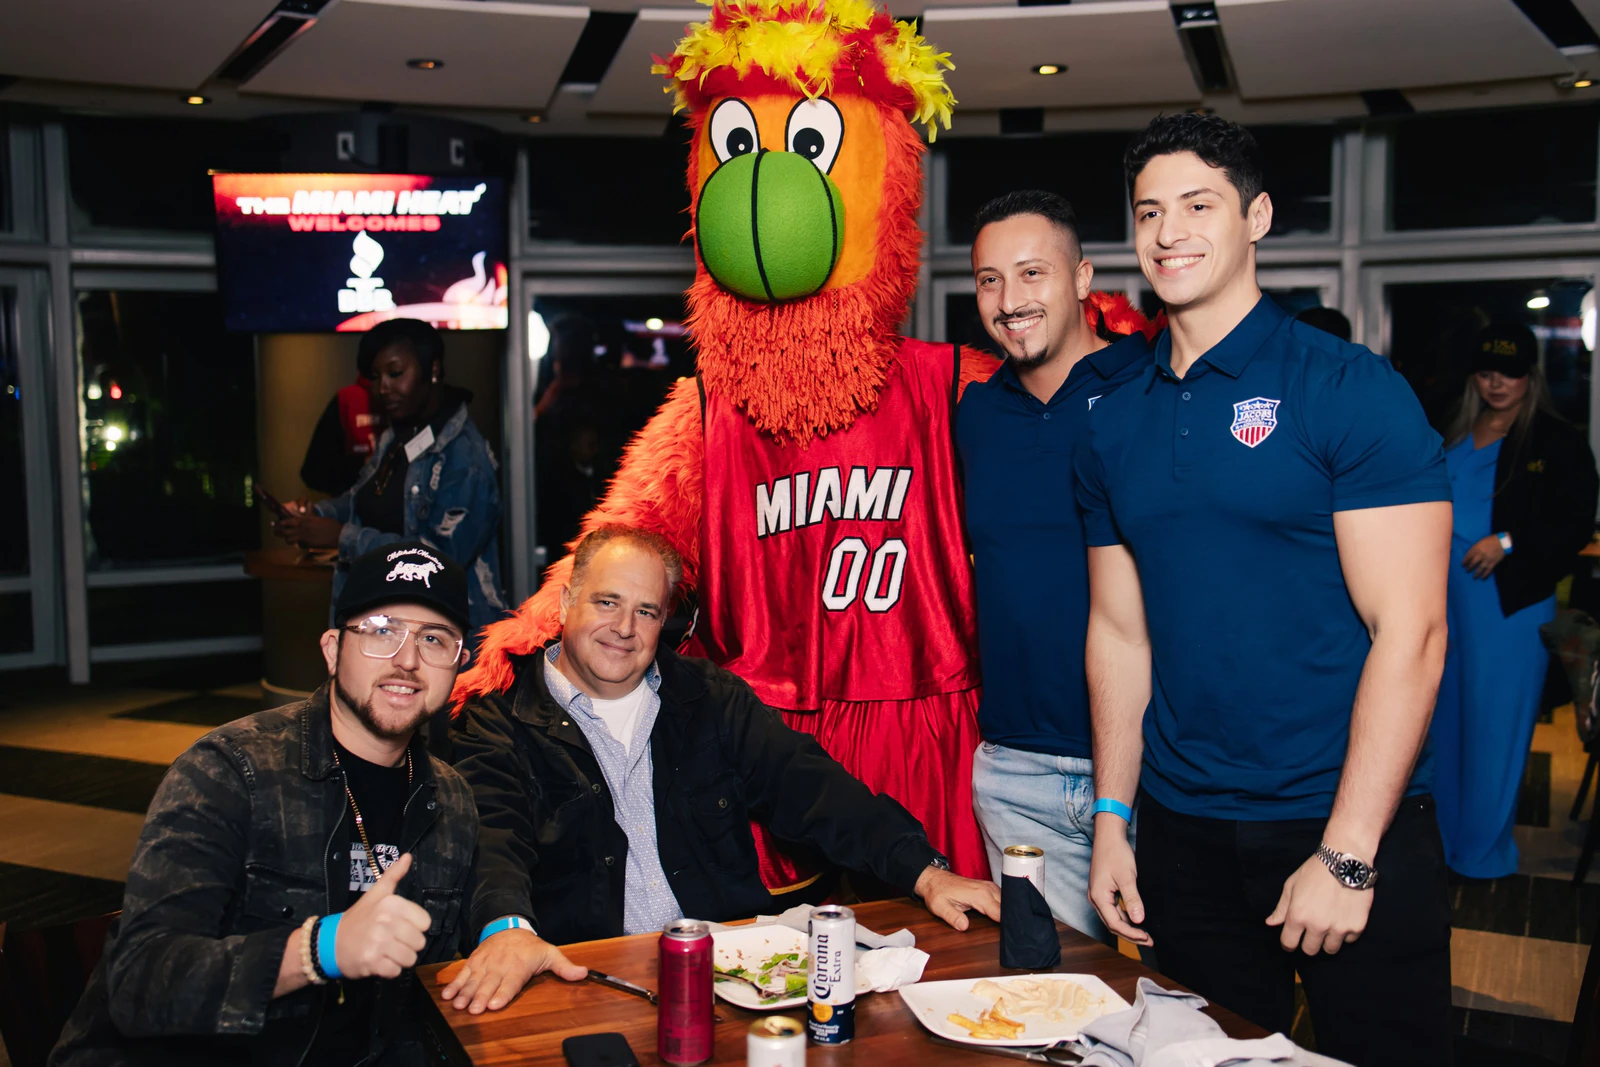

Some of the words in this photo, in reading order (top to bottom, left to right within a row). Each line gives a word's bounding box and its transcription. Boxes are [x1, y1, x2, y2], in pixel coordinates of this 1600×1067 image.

[236, 197, 290, 214] THE
[291, 190, 395, 214] MIAMI
[397, 183, 486, 214] HEAT
[288, 215, 441, 232] WELCOMES
[1238, 409, 1272, 421] JACOBS
[756, 465, 914, 540] MIAMI
[822, 536, 908, 614] 00
[813, 934, 831, 999] Corona
[829, 951, 841, 982] Extra
